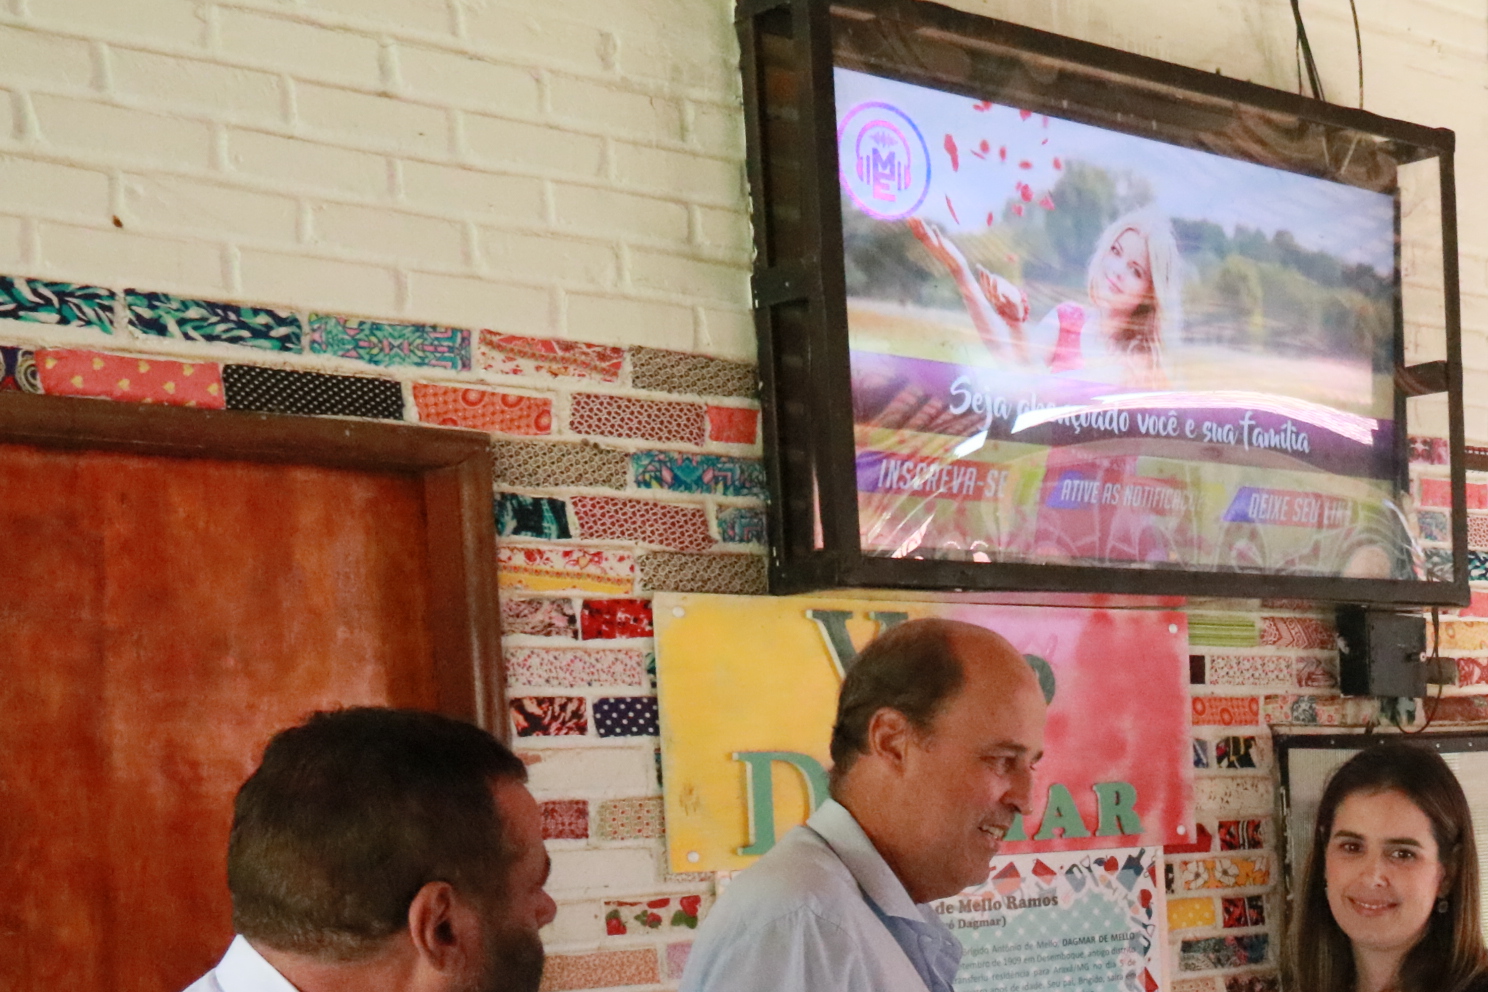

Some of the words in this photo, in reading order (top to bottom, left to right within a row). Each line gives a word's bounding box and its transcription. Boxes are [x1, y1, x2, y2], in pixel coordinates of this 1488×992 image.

[949, 376, 1010, 430] Seja
[1136, 409, 1181, 437] você
[1185, 418, 1199, 439] e
[1202, 420, 1240, 446] sua
[1239, 410, 1310, 455] família
[877, 459, 1008, 498] INSCREVA-SE
[1061, 479, 1099, 504] ATIVE
[1103, 482, 1121, 505] AS
[1248, 492, 1290, 521] DEIXE
[1292, 496, 1320, 523] SEU
[958, 897, 1002, 914] Mello
[1006, 895, 1059, 910] Ramos
[957, 916, 1007, 930] Dagmar)
[1062, 936, 1095, 946] DAGMAR
[1004, 957, 1022, 965] 1909
